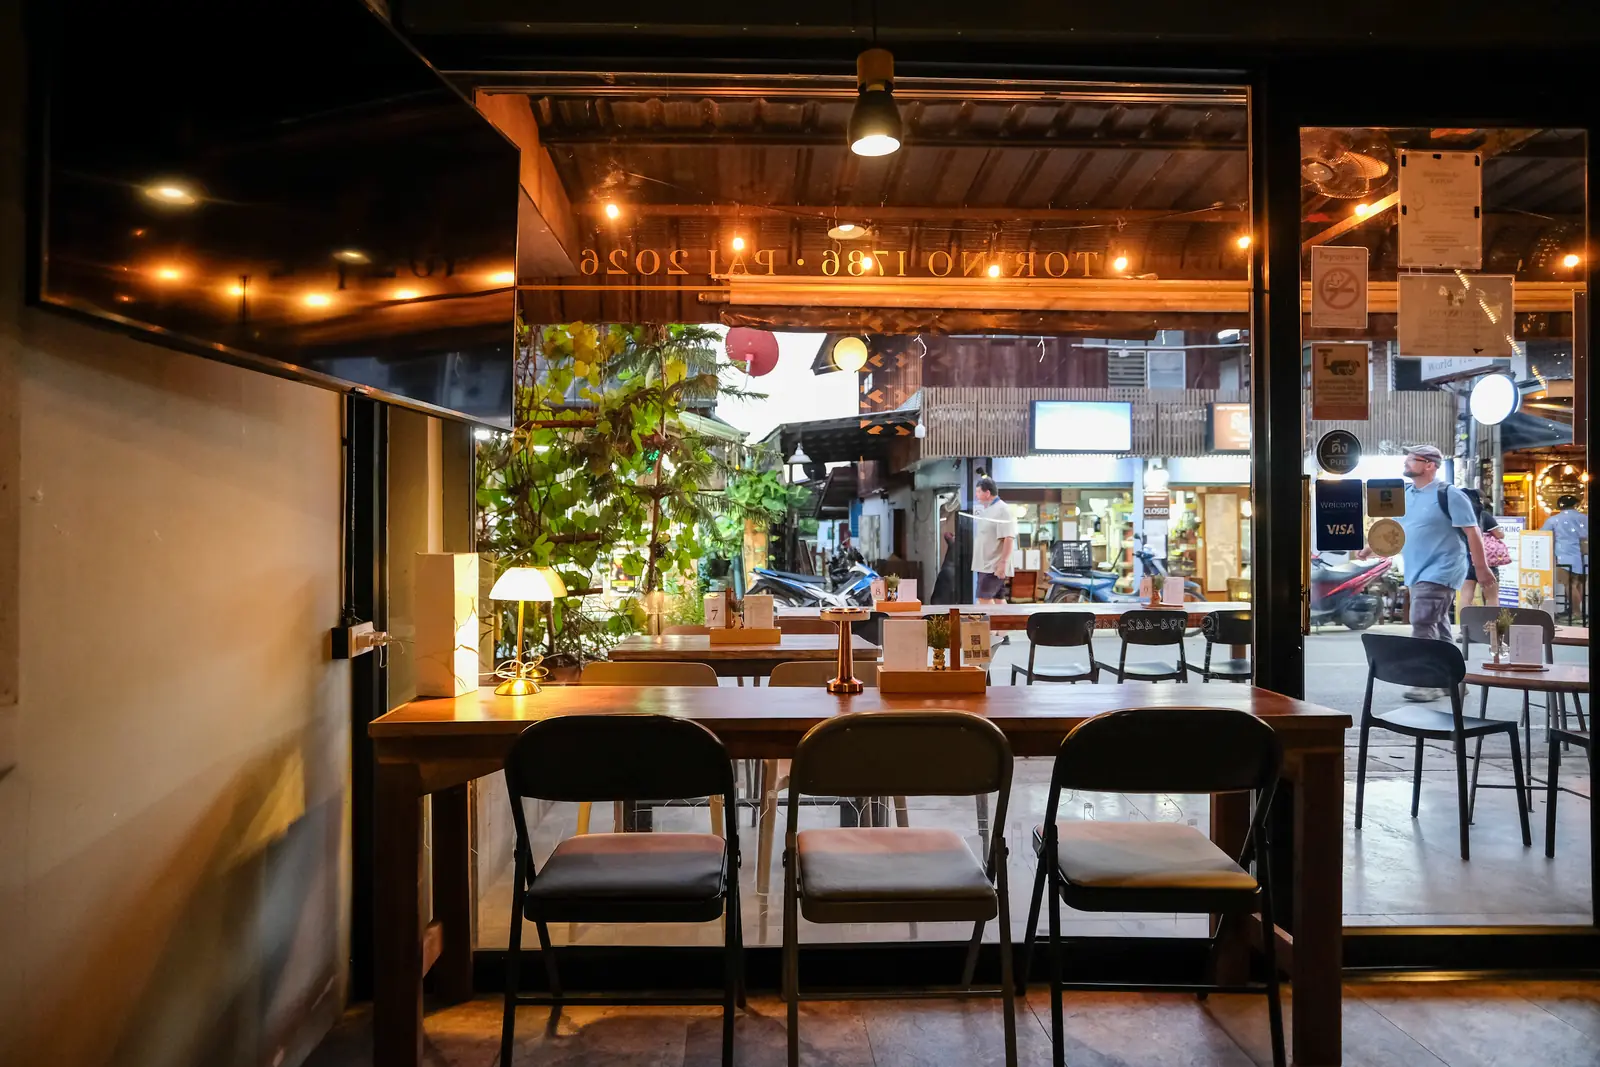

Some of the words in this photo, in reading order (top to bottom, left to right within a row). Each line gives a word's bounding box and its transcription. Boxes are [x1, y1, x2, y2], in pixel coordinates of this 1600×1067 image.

[1320, 500, 1359, 509] Welcome
[1144, 507, 1169, 515] CLOSED
[1326, 523, 1355, 535] VISA
[875, 588, 881, 596] 8
[711, 609, 719, 620] 7
